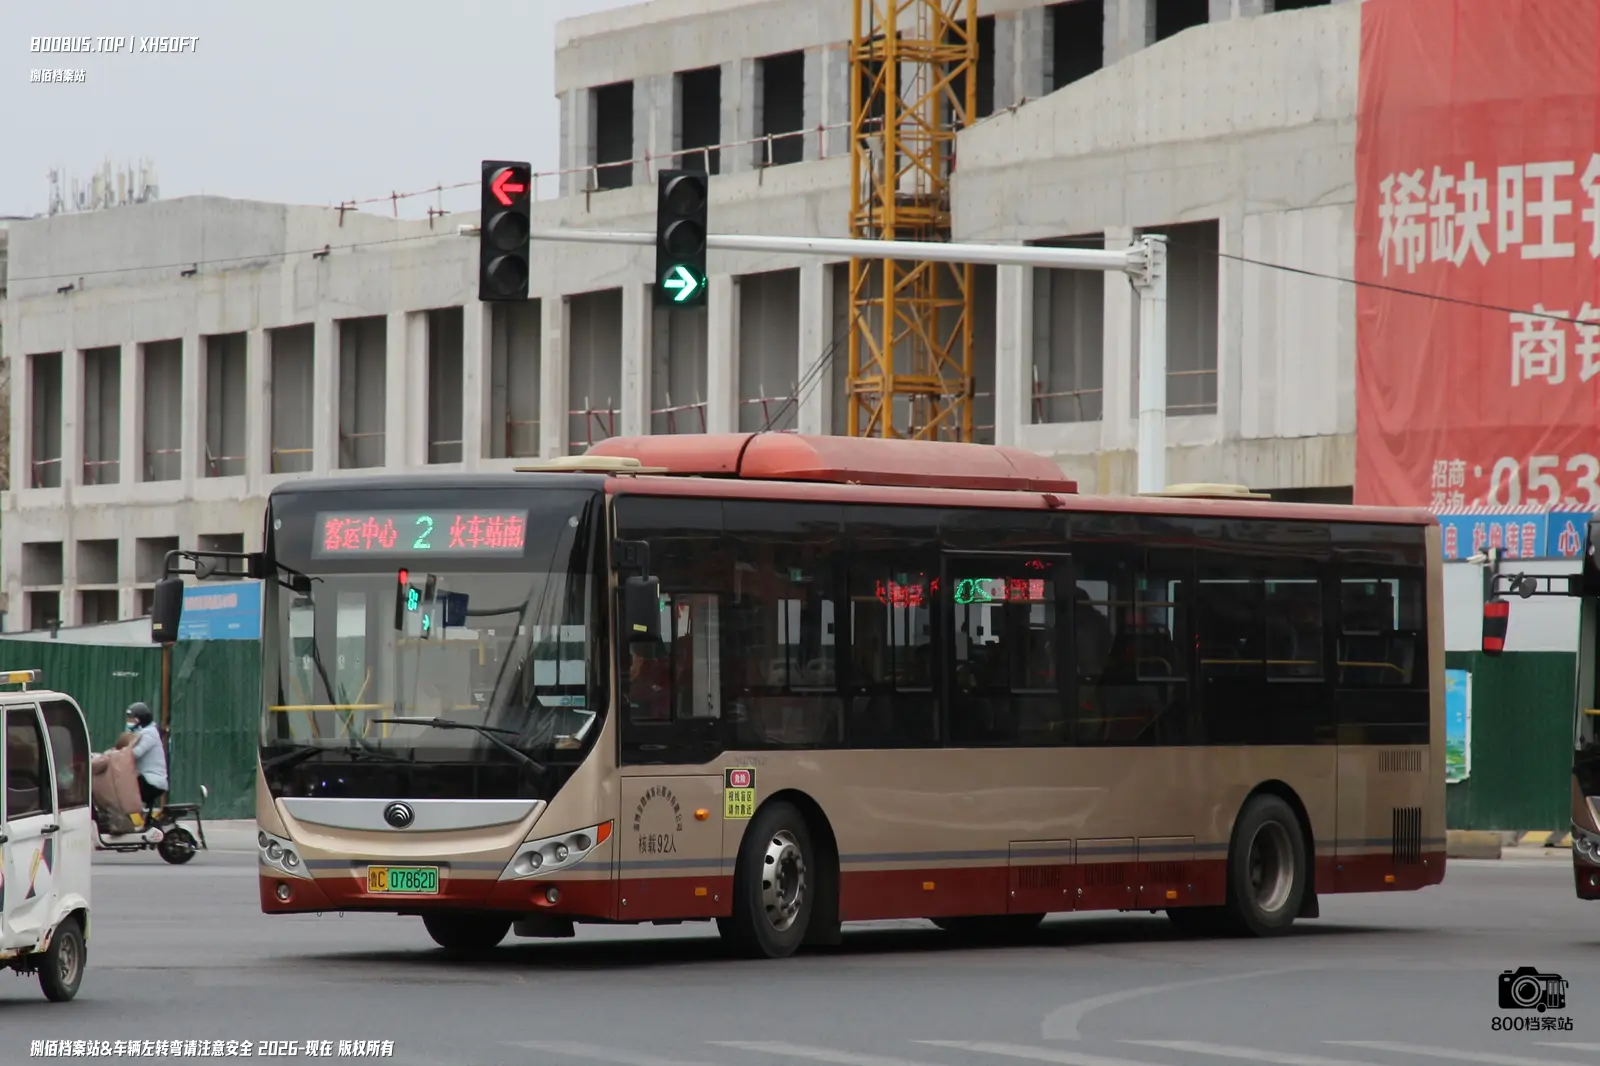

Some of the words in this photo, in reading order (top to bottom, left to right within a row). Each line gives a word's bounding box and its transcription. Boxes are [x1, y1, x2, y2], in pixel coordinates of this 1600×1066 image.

[1431, 458, 1467, 488] 招商
[324, 516, 398, 550] 客运中心
[413, 515, 434, 549] 2
[449, 515, 524, 548] 火车站南
[638, 833, 677, 854] 核载92人
